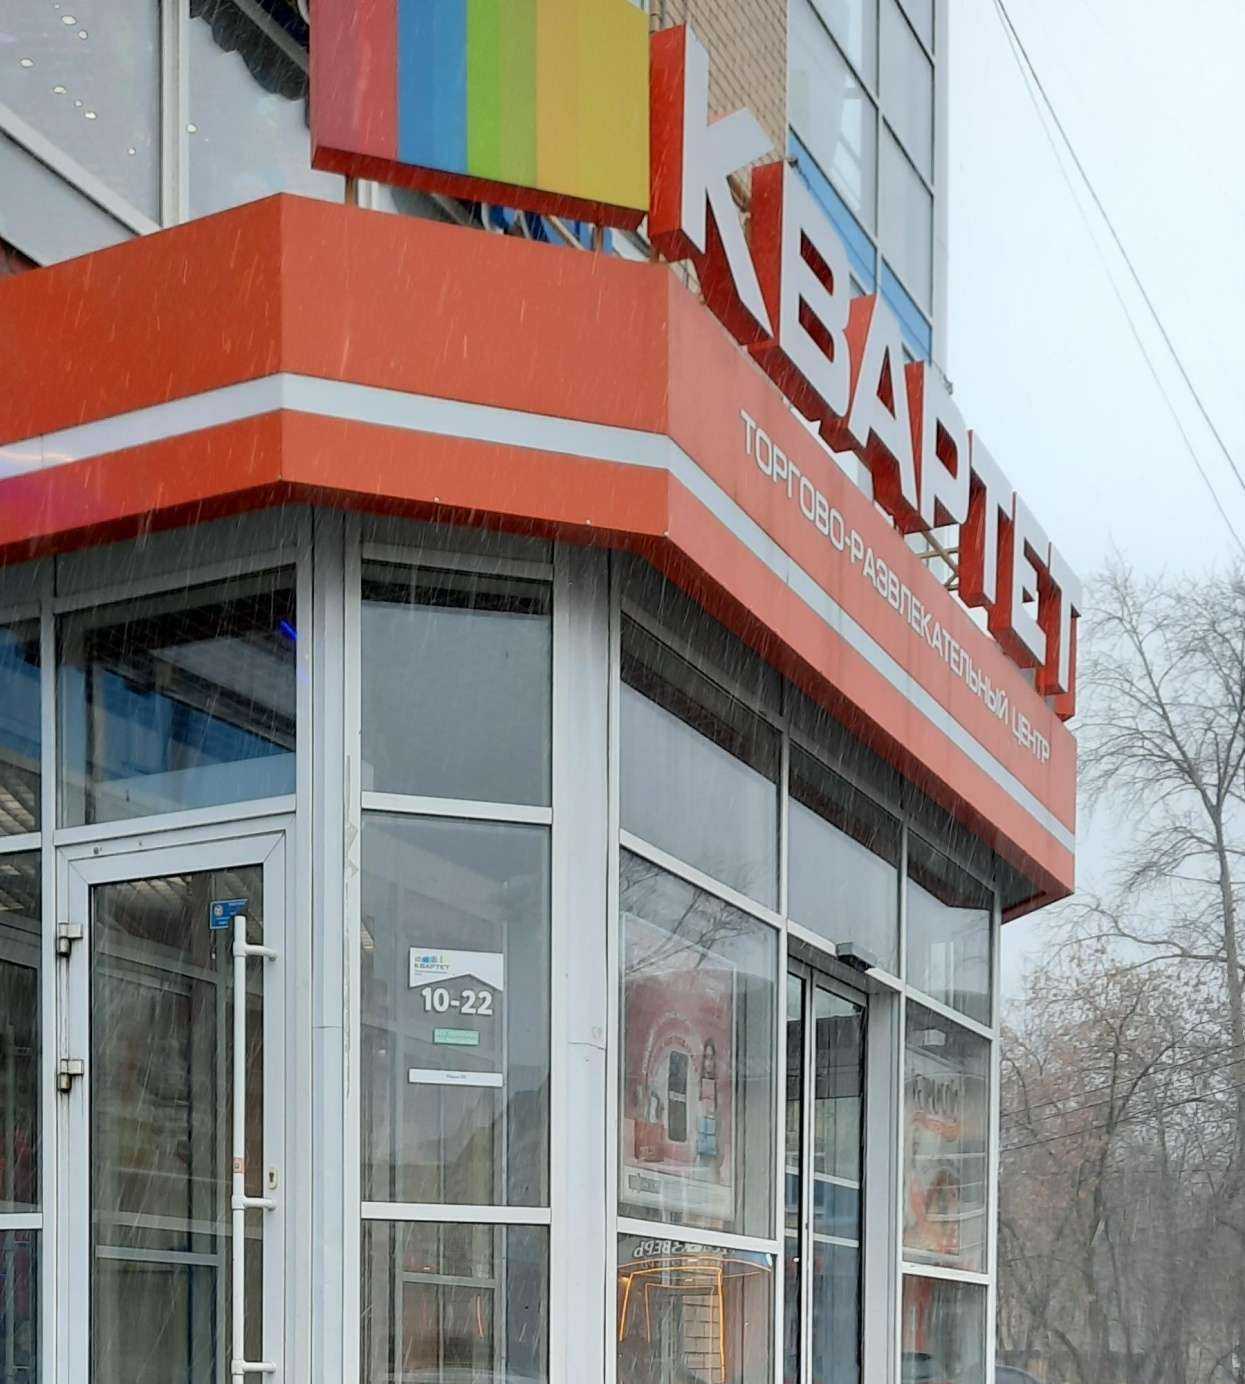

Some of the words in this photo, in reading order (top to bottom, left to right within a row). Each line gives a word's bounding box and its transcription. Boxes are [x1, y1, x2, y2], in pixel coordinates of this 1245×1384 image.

[680, 23, 1083, 695] КВАРТЕТ
[740, 408, 1010, 725] ТОРГОВО-РАЗВЛЕКАТЕЛЬНЫЙ
[1012, 705, 1051, 763] ЦЕНТР
[421, 986, 493, 1016] 10-22
